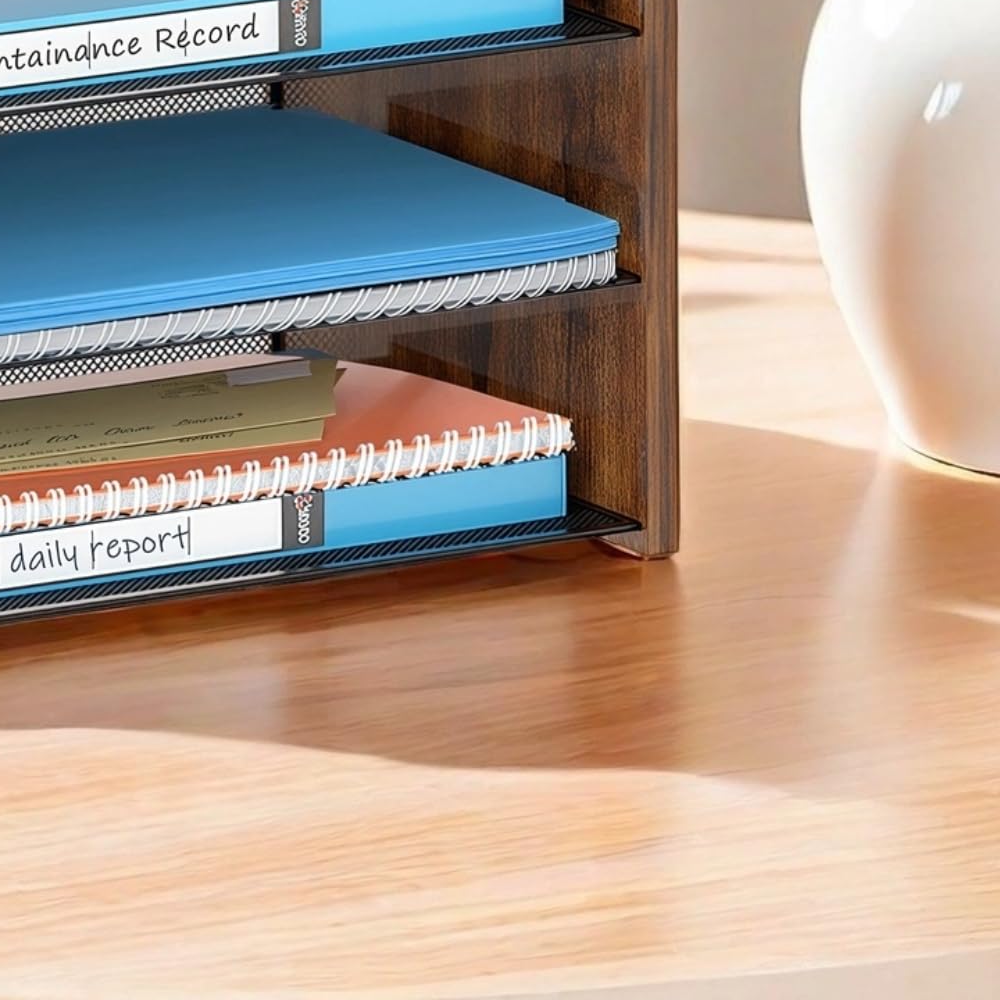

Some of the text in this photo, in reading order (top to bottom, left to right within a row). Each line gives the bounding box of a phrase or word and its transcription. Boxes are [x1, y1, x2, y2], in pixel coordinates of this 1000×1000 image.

[156, 12, 260, 55] Record
[10, 522, 190, 575] daily report
